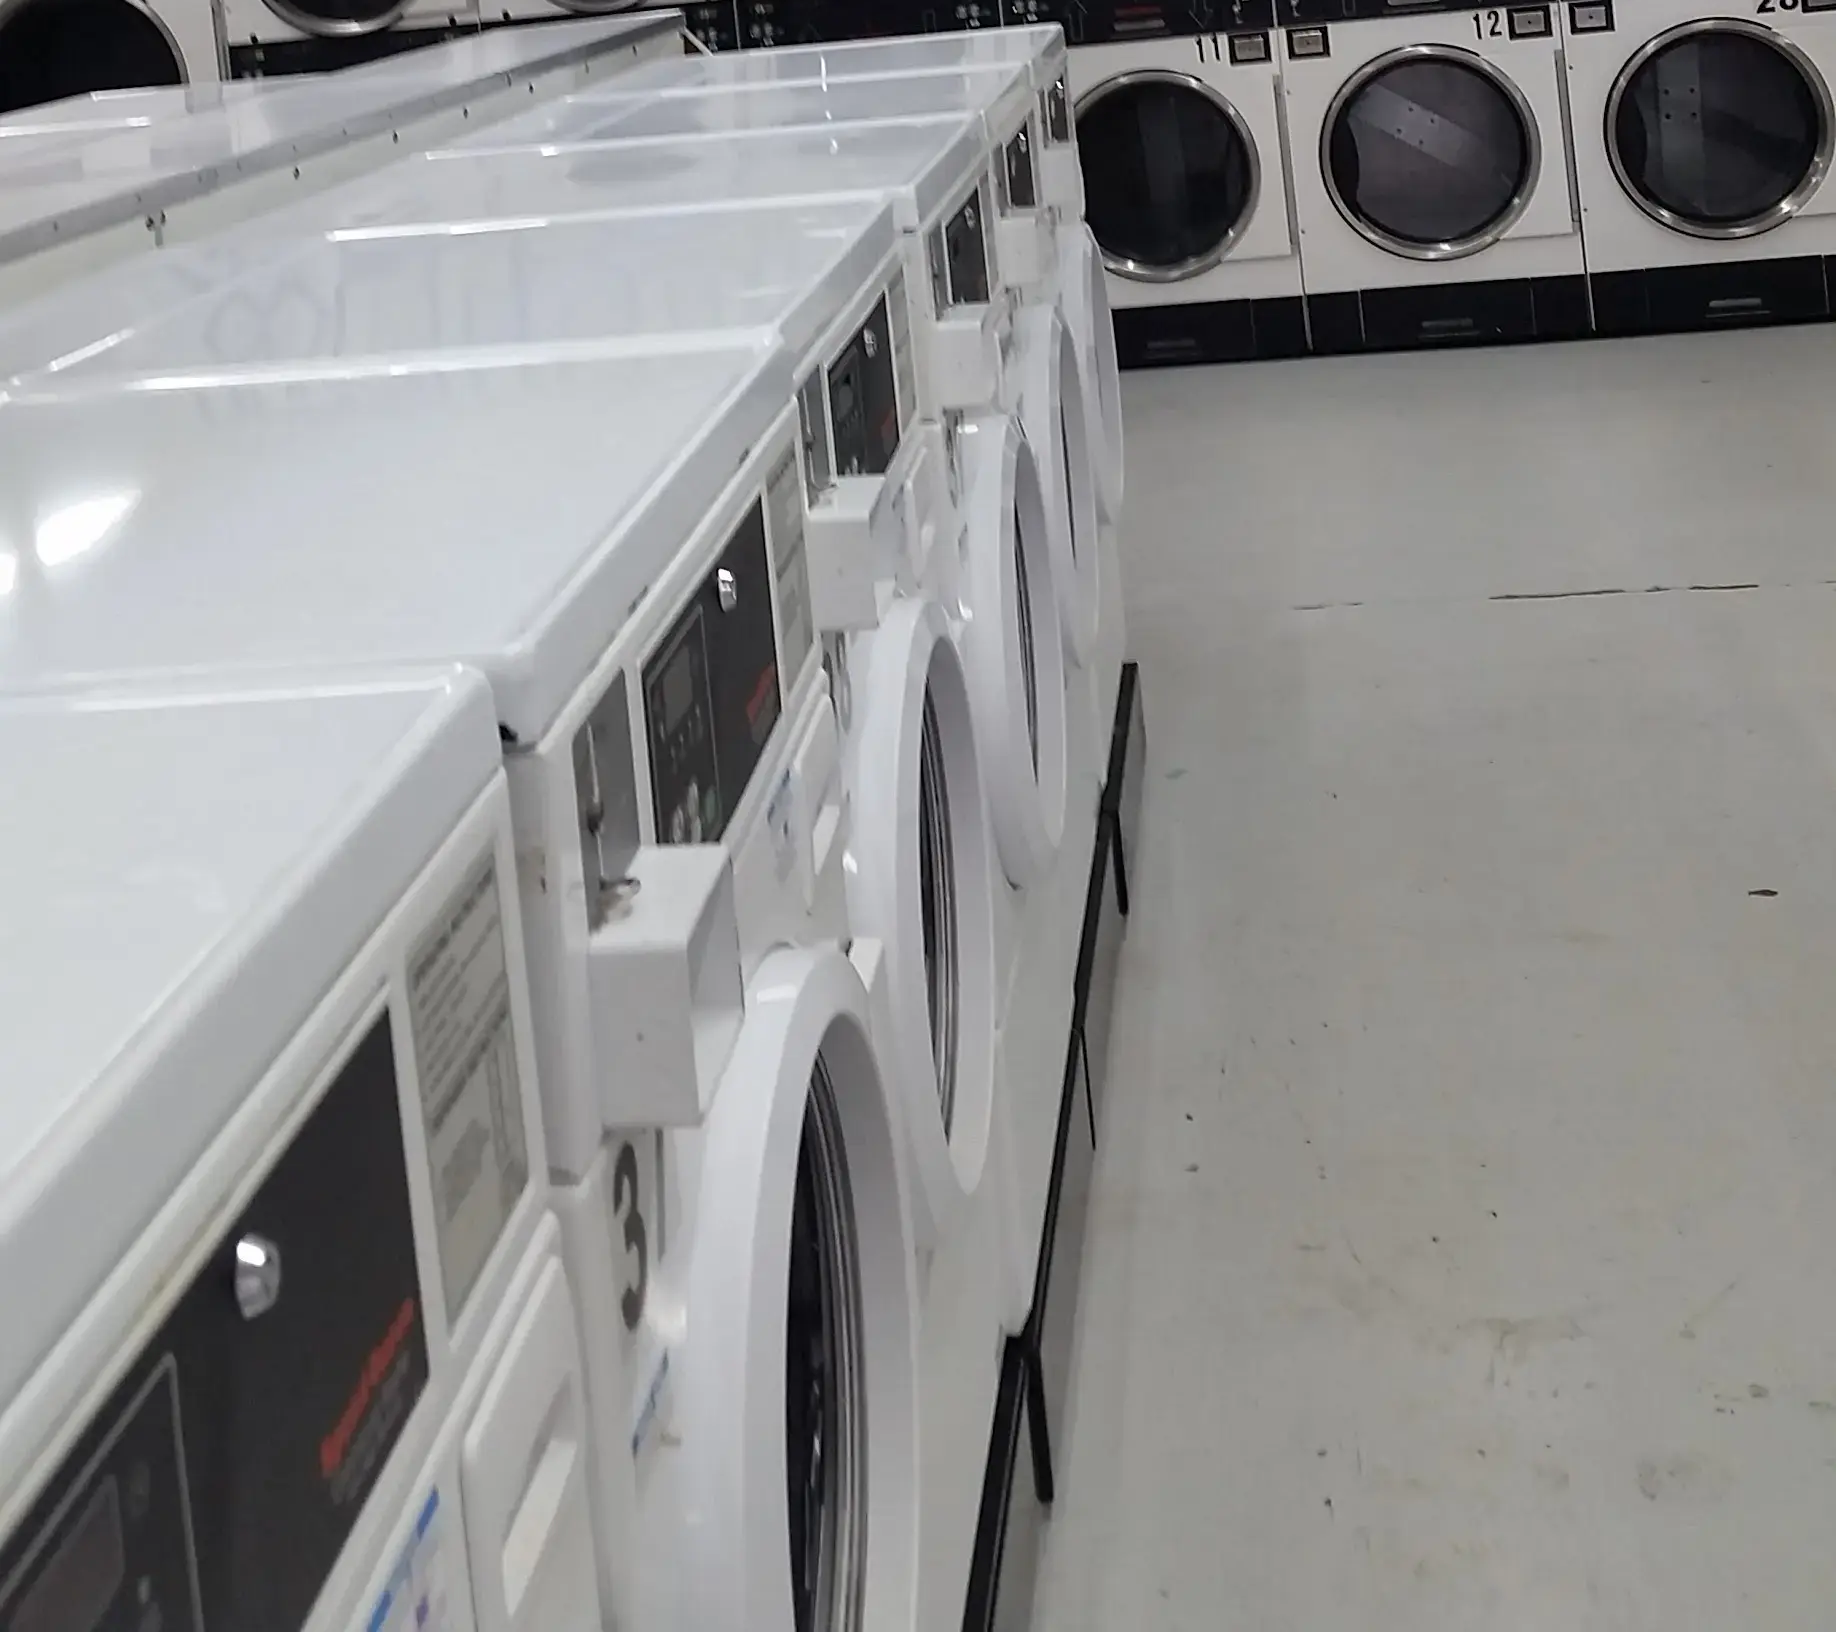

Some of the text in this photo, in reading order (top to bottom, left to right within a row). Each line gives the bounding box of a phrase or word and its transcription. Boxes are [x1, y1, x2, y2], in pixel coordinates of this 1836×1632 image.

[1473, 10, 1503, 40] 12
[1195, 32, 1221, 63] 11
[613, 1140, 648, 1333] 3
